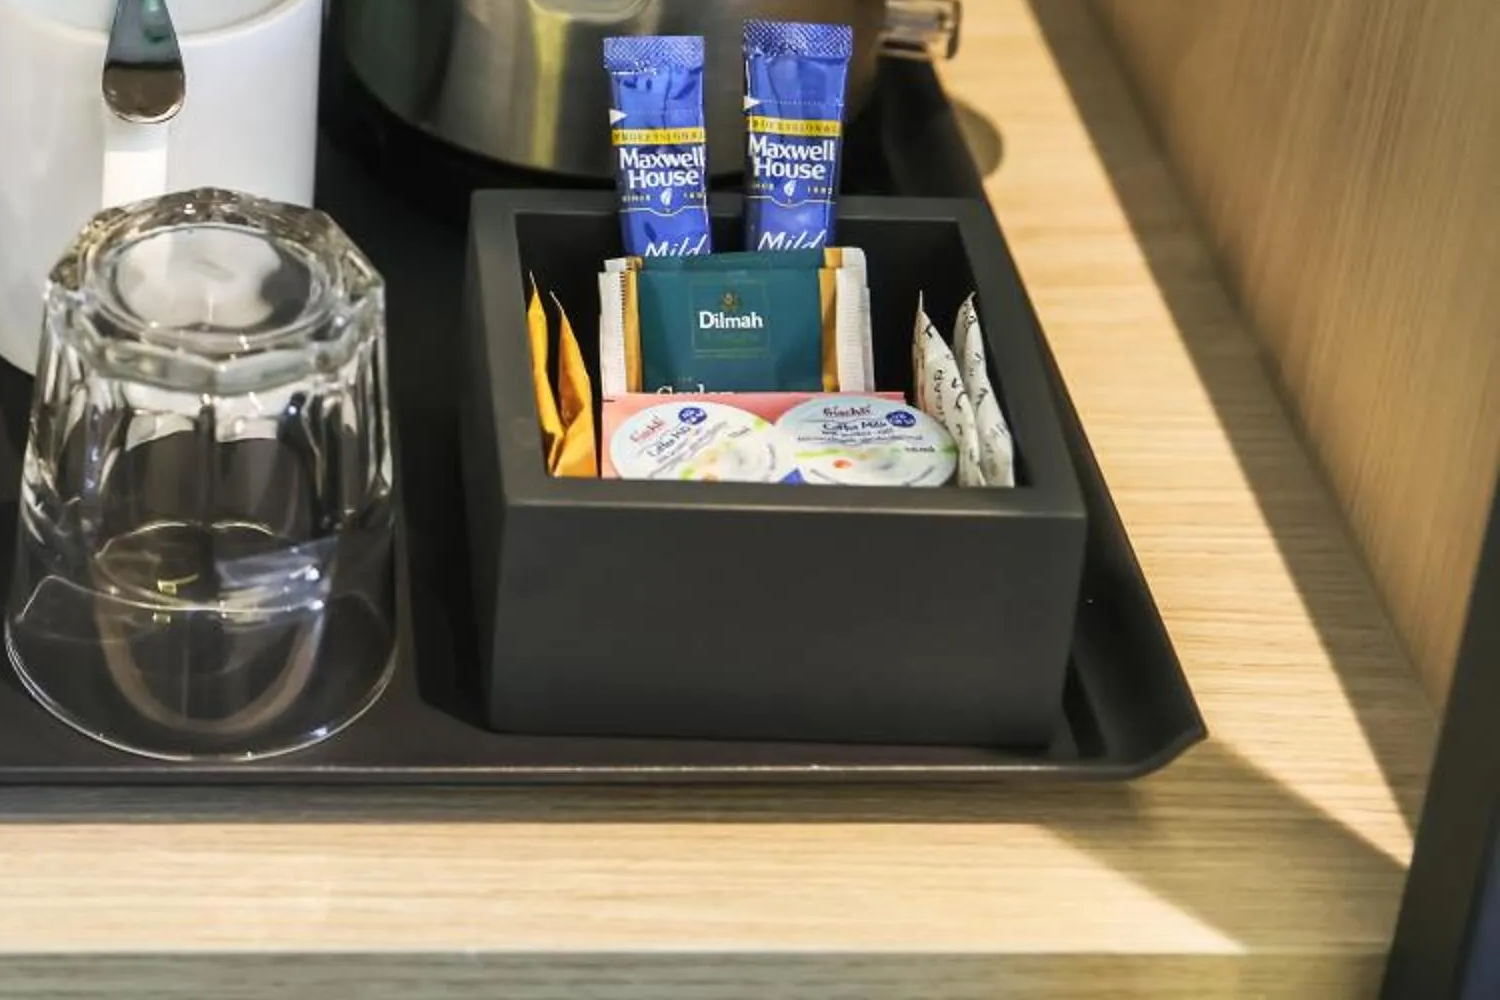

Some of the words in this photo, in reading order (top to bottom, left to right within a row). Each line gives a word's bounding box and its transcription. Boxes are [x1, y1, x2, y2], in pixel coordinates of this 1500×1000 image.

[619, 147, 705, 170] Maxwell
[748, 133, 835, 162] Maxwell
[627, 168, 700, 189] House
[753, 156, 827, 181] House
[757, 229, 828, 252] Mild
[698, 310, 765, 329] Dilmah
